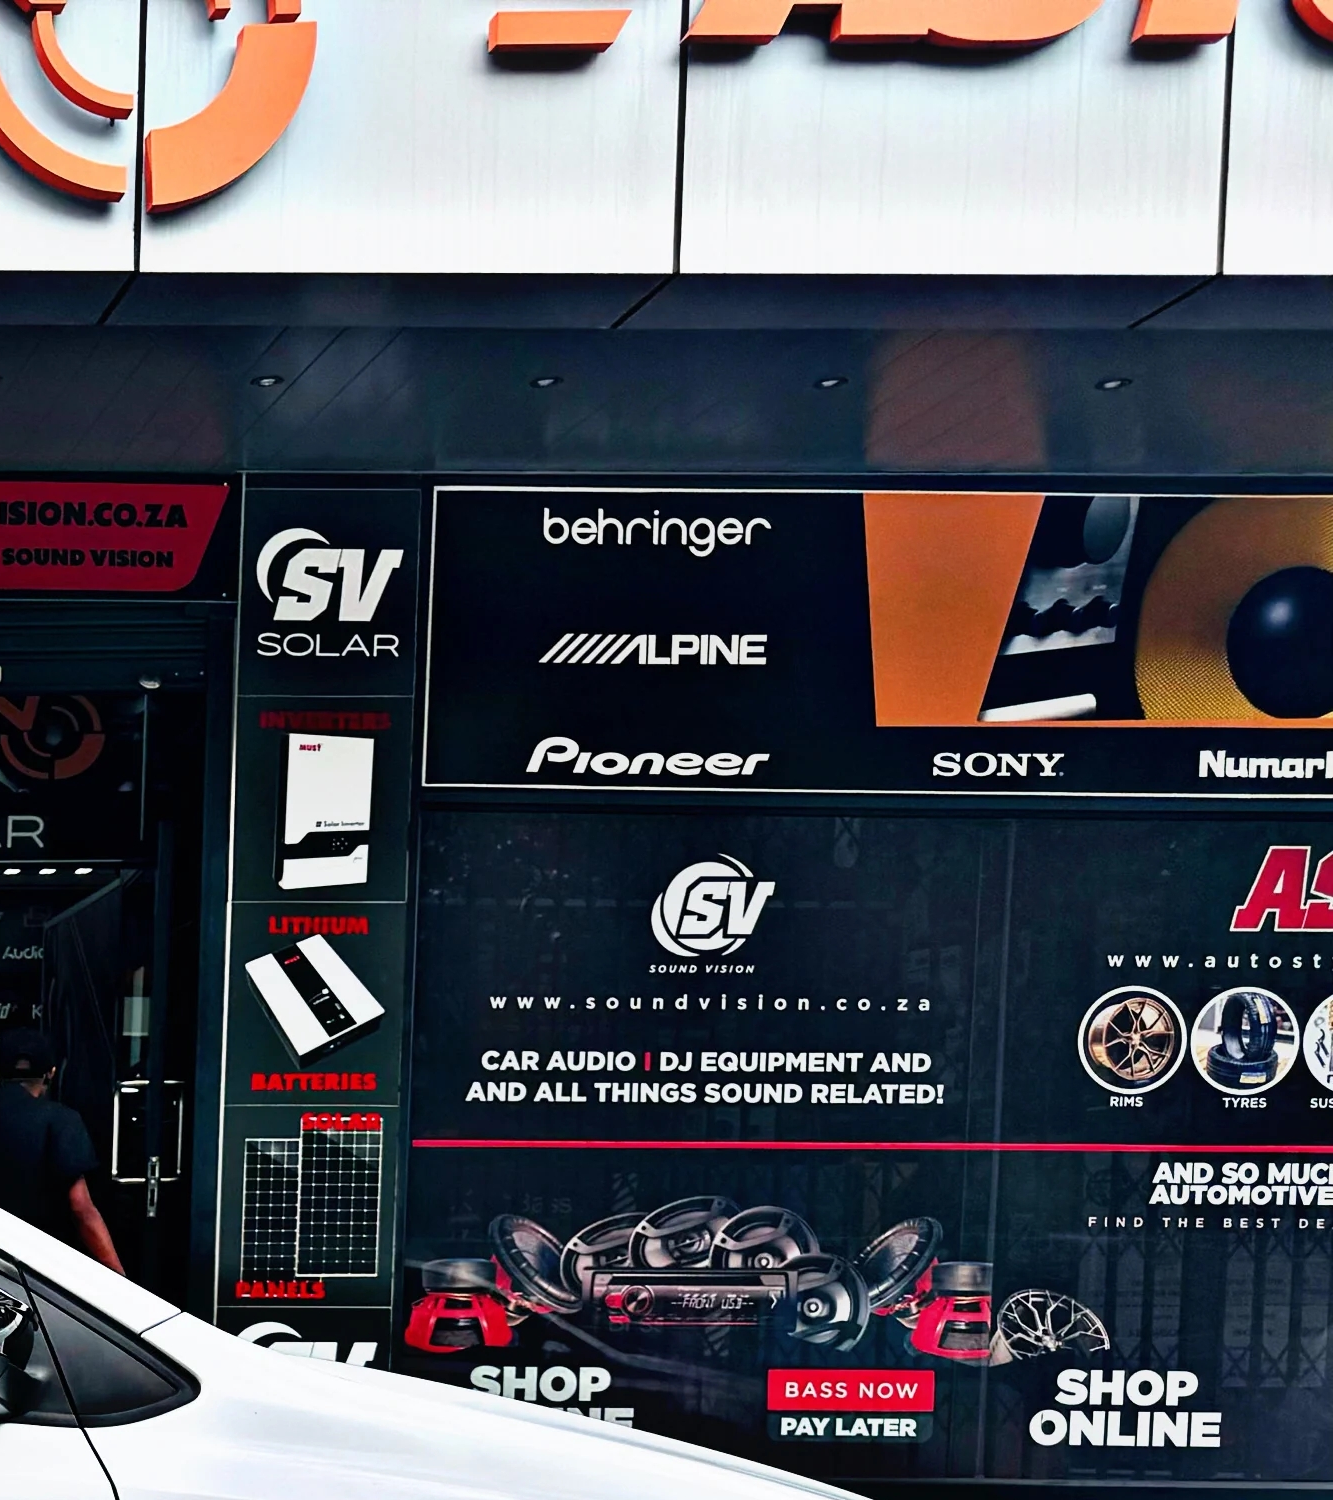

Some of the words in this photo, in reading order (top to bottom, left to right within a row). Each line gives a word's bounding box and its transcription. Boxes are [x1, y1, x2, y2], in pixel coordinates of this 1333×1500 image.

[542, 507, 772, 557] behringer
[1, 547, 85, 567] SOUND
[90, 549, 175, 569] VISION
[273, 548, 404, 622] SV
[257, 632, 400, 657] SOLAR
[610, 633, 768, 665] ALPINE
[259, 711, 391, 730] INVERTERS
[525, 736, 770, 776] Pioneer
[933, 752, 1065, 777] SONY
[677, 881, 776, 937] SV
[268, 915, 369, 935] LITHIUM
[648, 963, 698, 975] SOUND
[705, 963, 756, 976] VISION
[488, 992, 932, 1012] www.soundvision.co.za
[480, 1050, 539, 1072] CAR
[545, 1050, 636, 1072] AUDIO
[659, 1051, 693, 1073] DJ
[700, 1051, 864, 1075] EQUIPMENT
[869, 1052, 933, 1074] AND
[250, 1072, 377, 1092] BATTERIES
[464, 1080, 528, 1103] AND
[533, 1081, 587, 1104] ALL
[593, 1081, 698, 1104] THINGS
[703, 1082, 804, 1105] SOUND
[810, 1083, 945, 1105] RELATED!
[1109, 1096, 1144, 1108] RIMS
[1222, 1097, 1268, 1109] TYRES
[300, 1112, 383, 1131] SOLAR
[1152, 1162, 1214, 1185] AND
[1222, 1161, 1260, 1185] SO
[1148, 1184, 1333, 1206] AUTOMOTIVE
[1088, 1217, 1144, 1229] FIND
[1162, 1217, 1205, 1229] THE
[1223, 1217, 1281, 1230] BEST
[235, 1281, 326, 1300] PANELS
[469, 1366, 612, 1402] SHOP
[784, 1382, 848, 1399] BASS
[858, 1382, 919, 1400] NOW
[1054, 1368, 1199, 1407] SHOP
[780, 1417, 834, 1437] PAY
[835, 1417, 917, 1438] LATER
[1028, 1409, 1223, 1448] ONLINE
